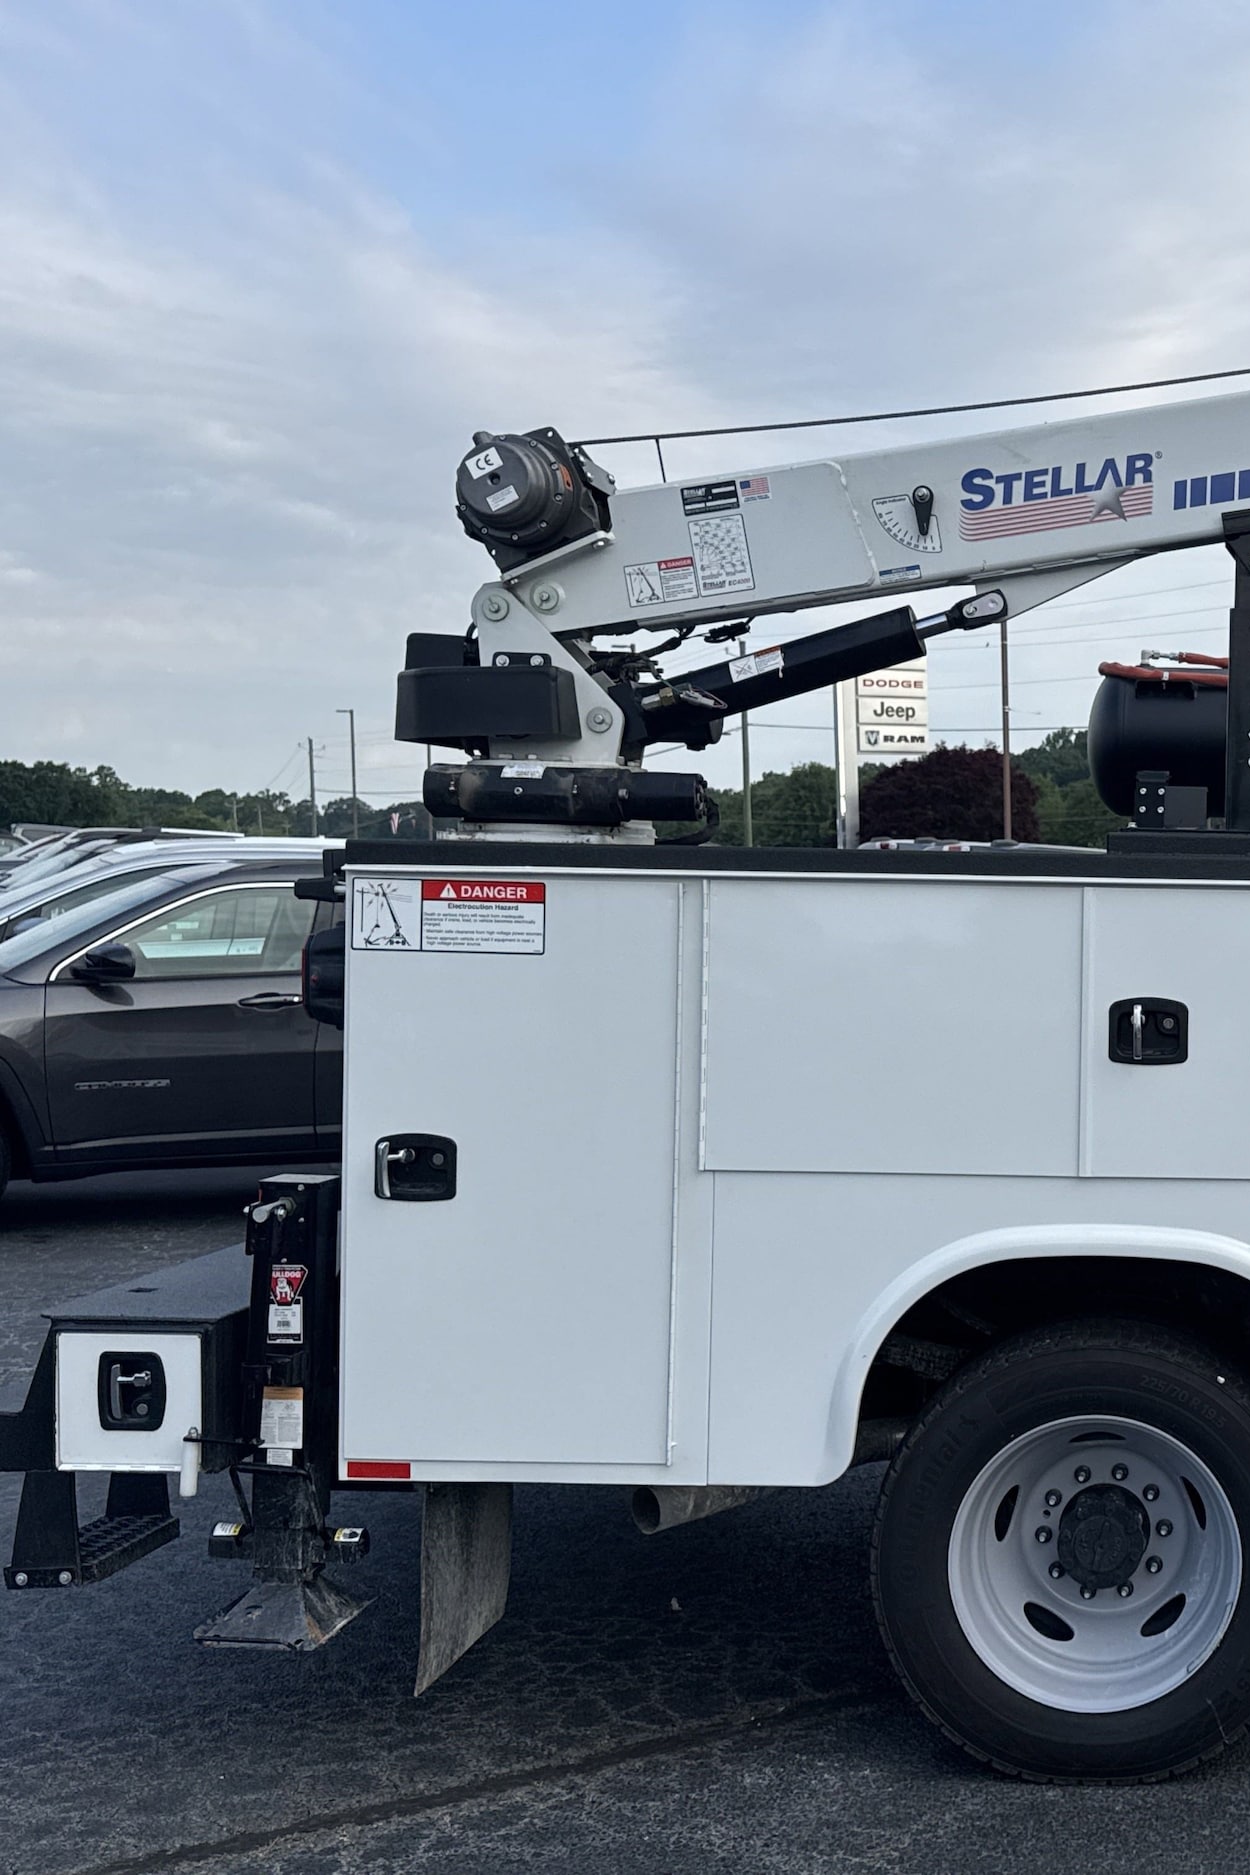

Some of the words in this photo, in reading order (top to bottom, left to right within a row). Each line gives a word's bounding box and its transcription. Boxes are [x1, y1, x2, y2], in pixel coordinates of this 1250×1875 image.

[960, 453, 1153, 511] STELLAR
[863, 679, 924, 689] DODGE
[873, 701, 916, 721] Jeep
[883, 735, 925, 743] RAM
[460, 885, 527, 899] DANGER
[447, 903, 493, 911] Electrocution
